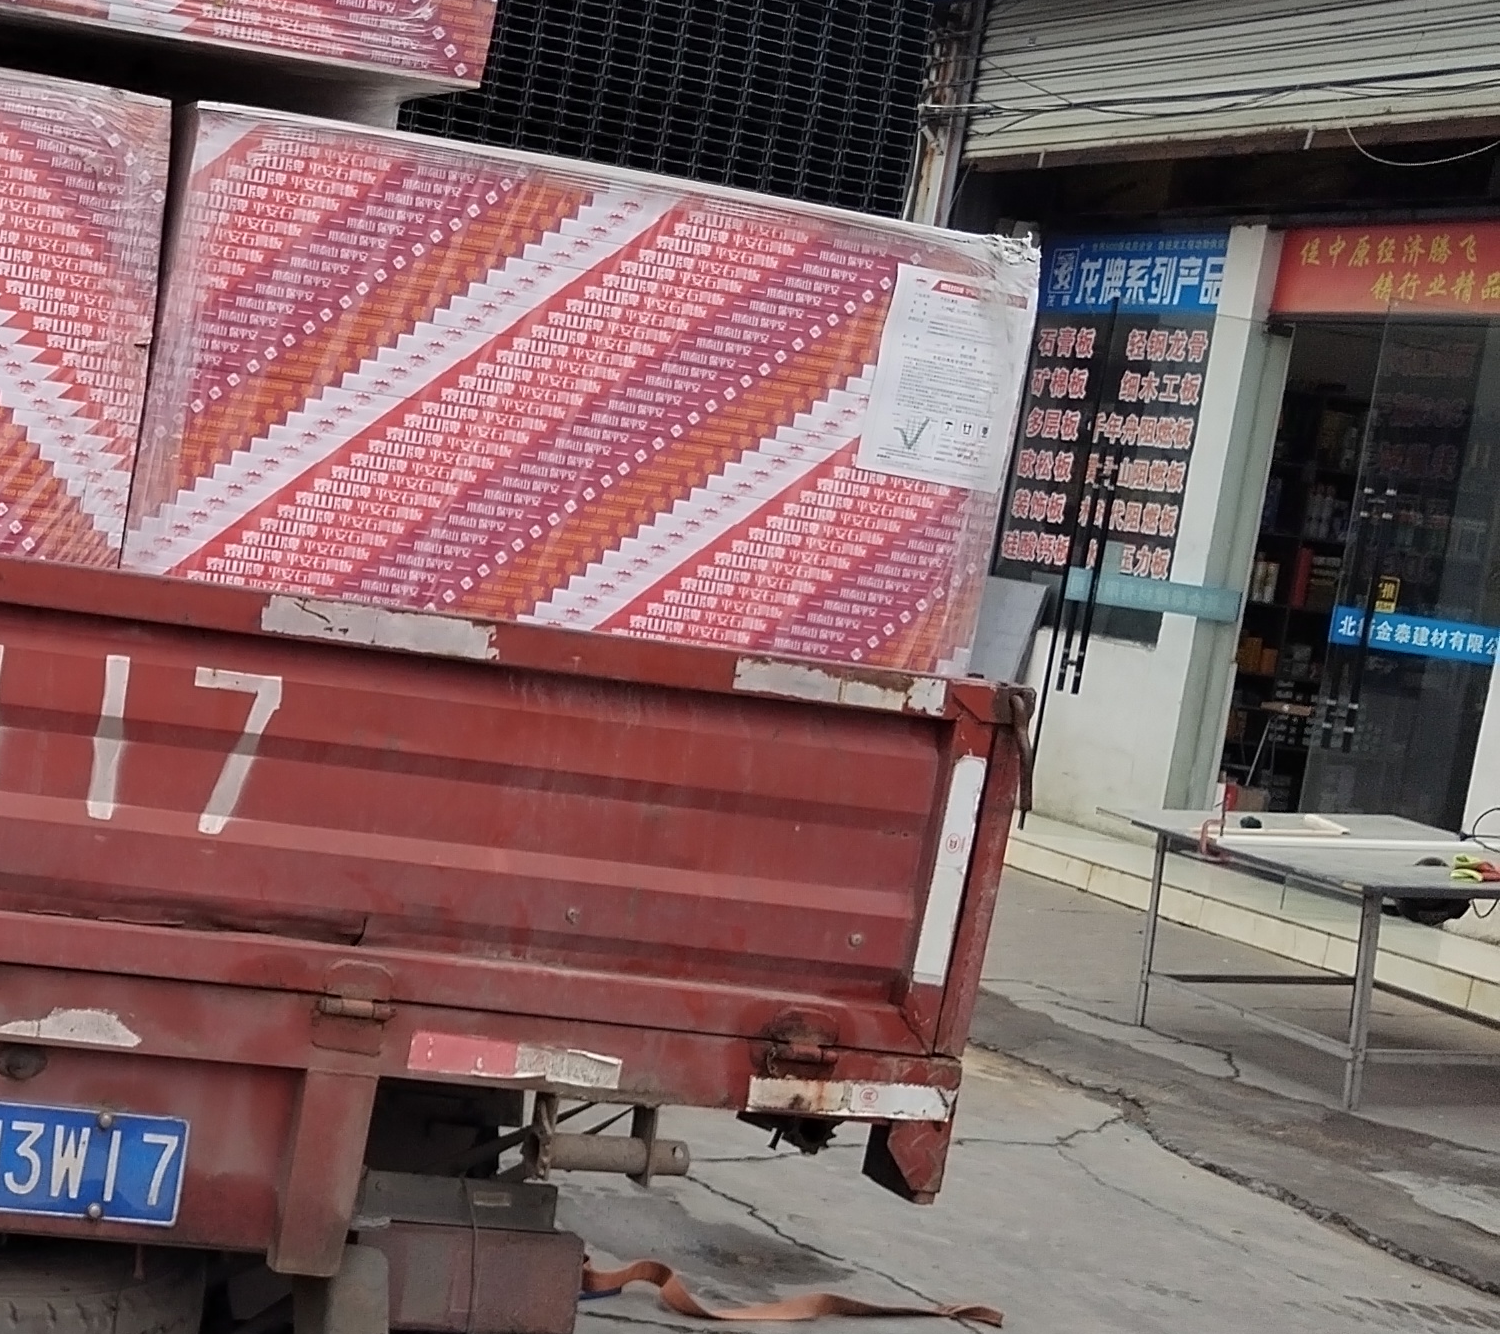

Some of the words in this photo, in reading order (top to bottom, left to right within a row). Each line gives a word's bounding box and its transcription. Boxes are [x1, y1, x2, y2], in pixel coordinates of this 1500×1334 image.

[227, 165, 286, 186] 泰山牌
[656, 236, 712, 256] 泰山牌
[1075, 255, 1226, 305] 龙牌系列产品
[584, 286, 640, 306] 泰山牌
[1038, 327, 1096, 358] 石膏板
[1126, 328, 1208, 362] 轻钢龙骨
[1030, 367, 1089, 399] 矿棉板
[1118, 370, 1202, 405] 细木工板
[441, 388, 497, 408] 泰山牌
[1025, 407, 1081, 441] 多层板
[368, 439, 426, 459] 泰山牌
[1016, 448, 1074, 482] 欧松板
[314, 478, 372, 498] 泰山牌
[1011, 488, 1067, 524] 装饰板
[260, 517, 318, 537] 泰山牌
[732, 540, 786, 559] 泰山牌
[1001, 529, 1071, 565] 硅酸钙板
[697, 565, 751, 584] 泰山牌
[647, 602, 701, 621] 泰山牌
